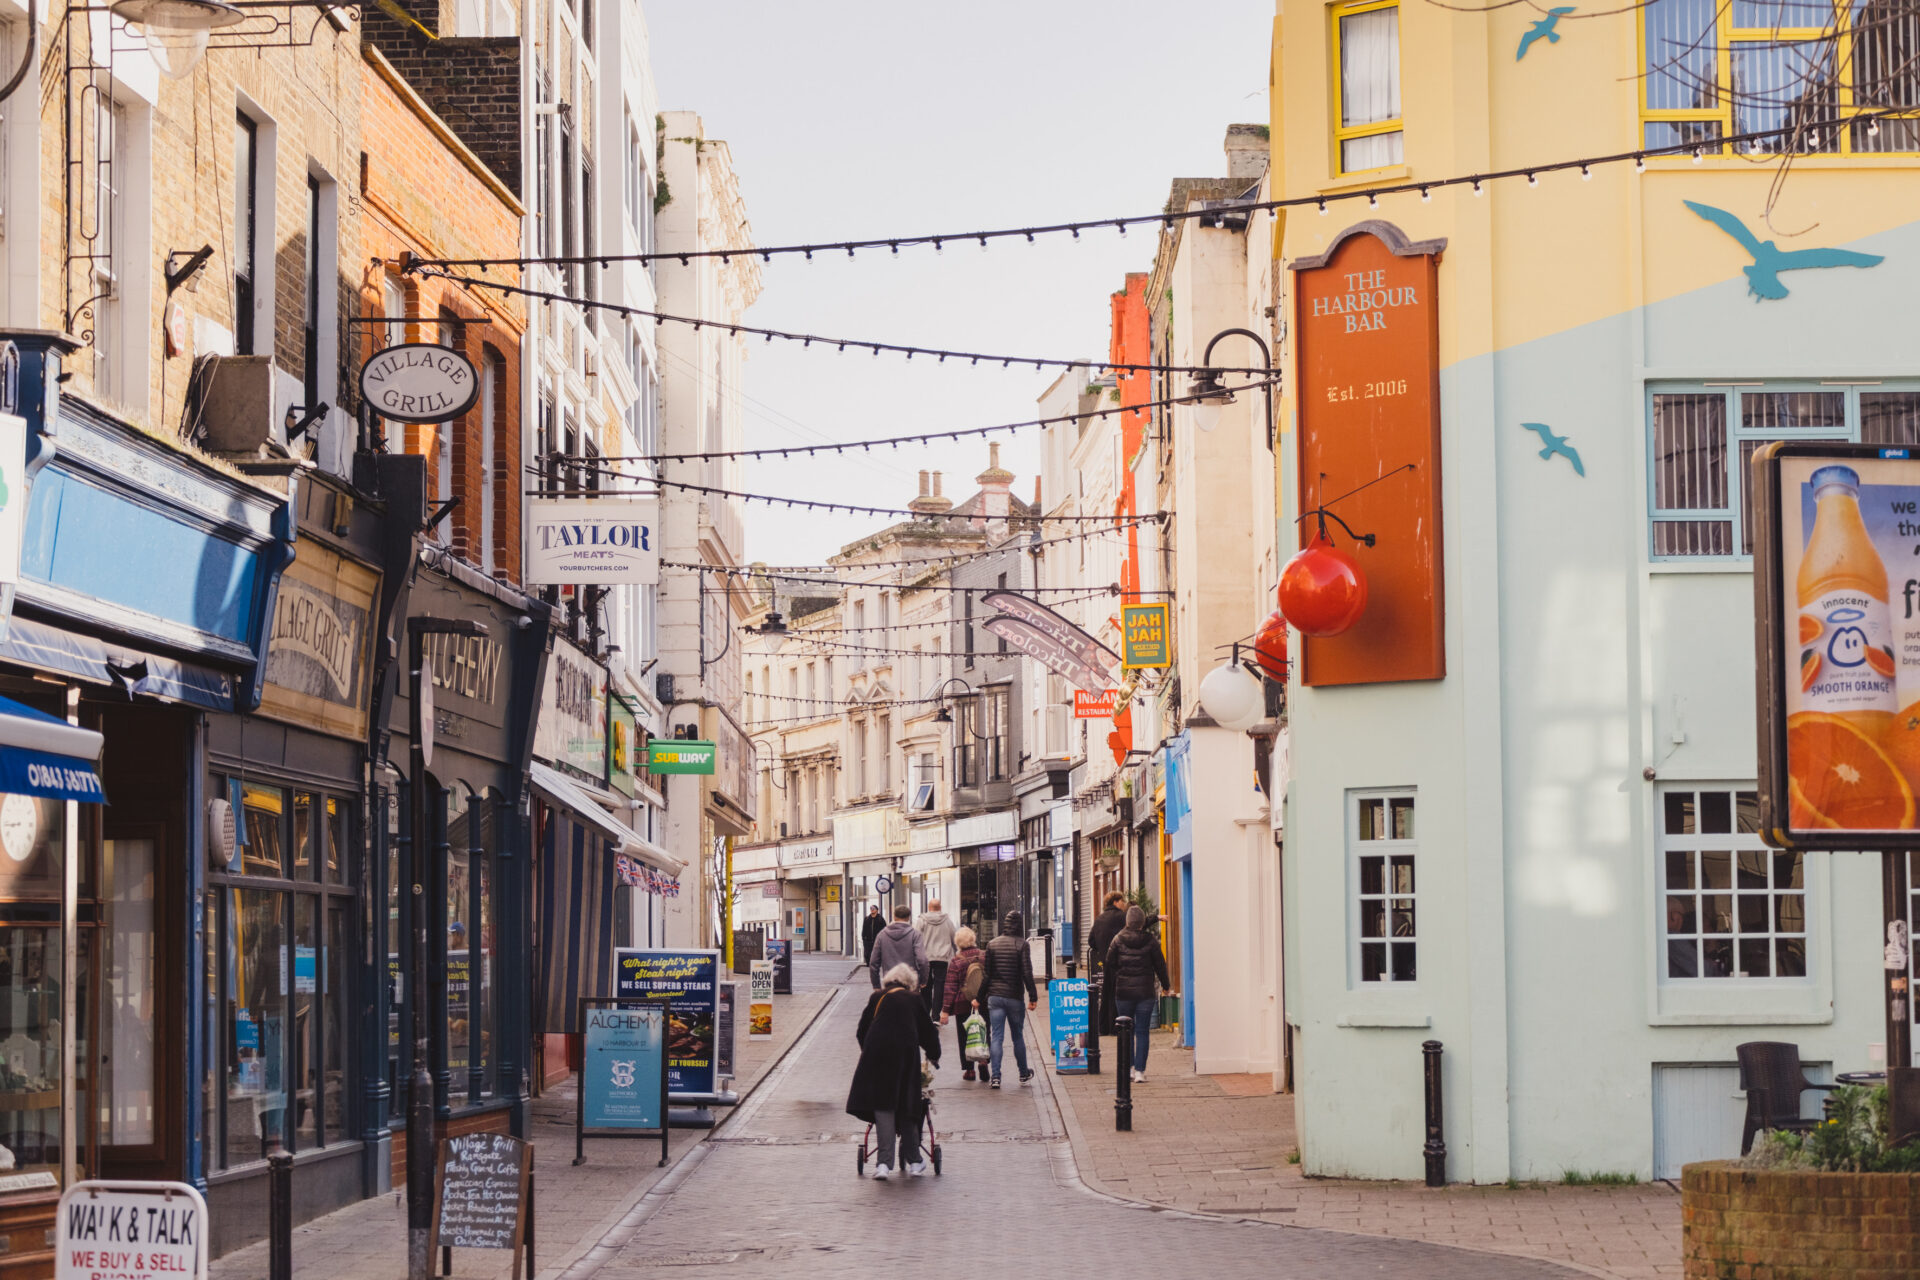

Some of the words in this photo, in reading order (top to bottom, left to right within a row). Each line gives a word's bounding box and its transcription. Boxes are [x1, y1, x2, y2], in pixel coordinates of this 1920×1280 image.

[1344, 269, 1386, 292] THE
[1312, 287, 1419, 316] HARBOUR
[1344, 311, 1387, 334] BAR
[368, 351, 467, 385] VILLAGE
[1327, 385, 1359, 403] Est.
[1364, 379, 1407, 399] 2006
[383, 389, 453, 413] GRILL
[1890, 502, 1917, 514] we
[537, 524, 651, 551] TAYLOR
[573, 551, 614, 559] MEATS
[1822, 597, 1870, 610] innocent
[1128, 613, 1162, 628] JAH
[270, 594, 313, 645] LAGE
[313, 608, 348, 686] GRILL
[1128, 628, 1162, 642] JAH
[1811, 681, 1852, 697] SMOOTH
[1855, 680, 1890, 693] ORANGE
[1078, 708, 1114, 716] RESTAURAN
[653, 752, 711, 764] SUBWAY
[622, 958, 652, 968] What
[687, 956, 711, 968] your
[635, 968, 665, 980] Steak
[665, 967, 698, 979] night?
[752, 971, 772, 980] NOW
[621, 981, 633, 989] WE
[634, 981, 651, 989] SELL
[653, 982, 681, 990] SUPERB
[683, 982, 711, 990] STEAKS
[752, 980, 772, 989] OPEN
[1063, 996, 1088, 1007] ITec
[589, 1015, 660, 1029] ALCHEMY
[450, 1137, 487, 1153] Village
[127, 1206, 139, 1243] &
[147, 1208, 195, 1246] TALK
[72, 1250, 94, 1268] WE
[99, 1251, 130, 1269] BUY
[135, 1252, 145, 1270] &
[150, 1253, 187, 1272] SELL
